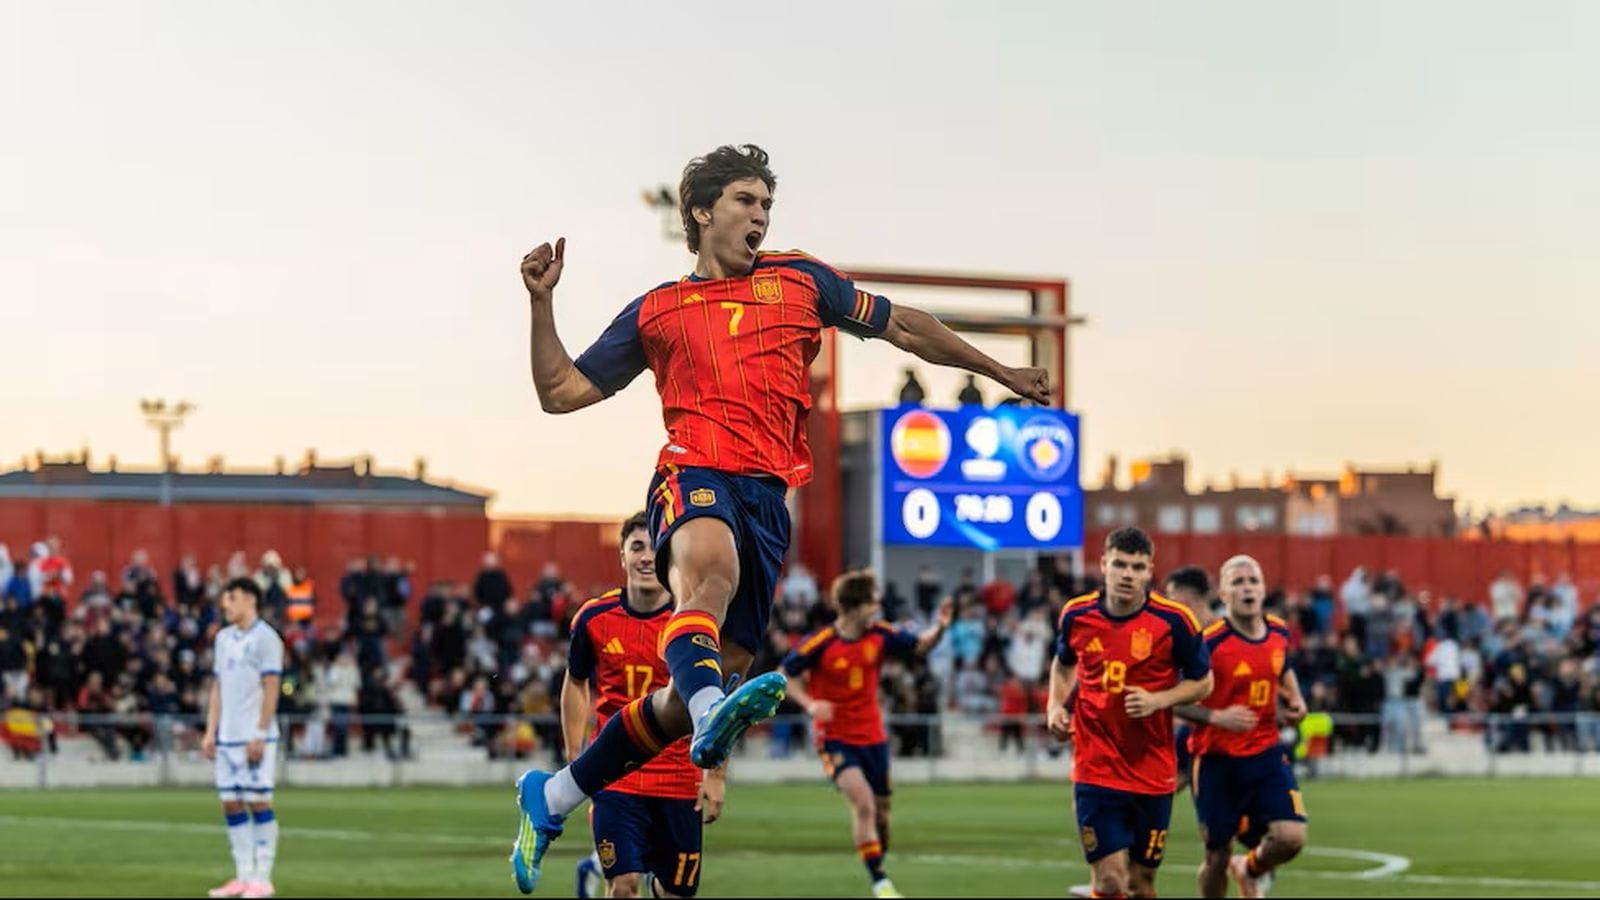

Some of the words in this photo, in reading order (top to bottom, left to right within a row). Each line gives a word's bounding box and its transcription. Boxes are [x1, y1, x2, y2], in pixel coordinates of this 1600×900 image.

[721, 302, 744, 336] 7
[903, 489, 940, 538] 0
[1026, 492, 1062, 541] 0
[625, 665, 653, 697] 17
[1102, 661, 1126, 693] 19
[1250, 680, 1269, 706] 10
[1147, 829, 1167, 859] 19
[674, 853, 700, 886] 17
